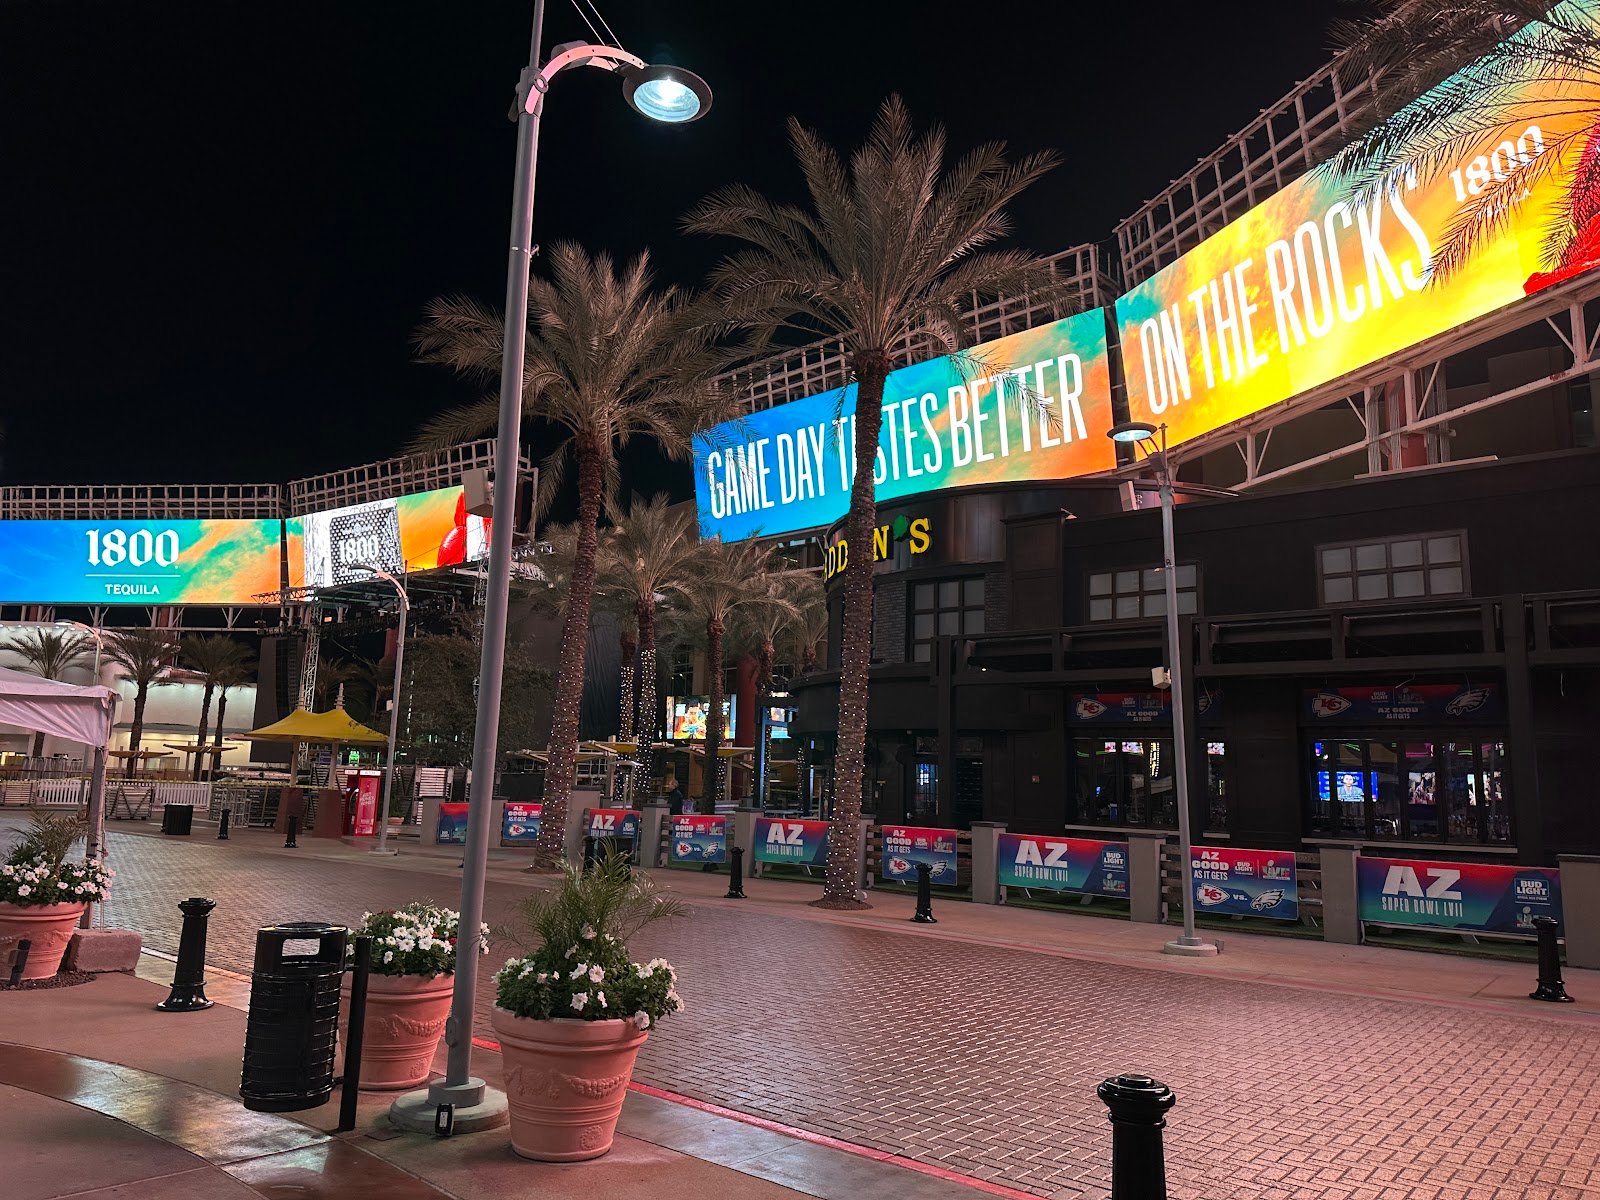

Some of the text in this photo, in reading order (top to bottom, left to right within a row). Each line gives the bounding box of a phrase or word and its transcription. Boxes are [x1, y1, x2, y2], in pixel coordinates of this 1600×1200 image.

[1449, 125, 1544, 203] 1800
[1140, 164, 1434, 415] ON THE ROCKS
[708, 437, 774, 519] GAME
[777, 423, 826, 502] DAY
[948, 353, 1088, 468] BETTER
[85, 528, 179, 567] 1800
[339, 535, 379, 564] 1800
[105, 584, 160, 595] TEQUILA
[592, 814, 615, 830] AZ
[767, 823, 804, 845] AZ
[886, 837, 912, 845] GOOD
[1015, 840, 1068, 868] AZ
[1201, 851, 1220, 860] AZ
[1014, 866, 1068, 882] SUPER BOWL LVII
[1192, 860, 1230, 870] GOOD
[1194, 870, 1203, 879] AS
[1204, 871, 1210, 879] IT
[1211, 871, 1228, 880] GETS
[1382, 865, 1462, 900] AZ
[1516, 886, 1547, 896] LIGHT
[1381, 897, 1463, 918] SUPER BOWL LVII
